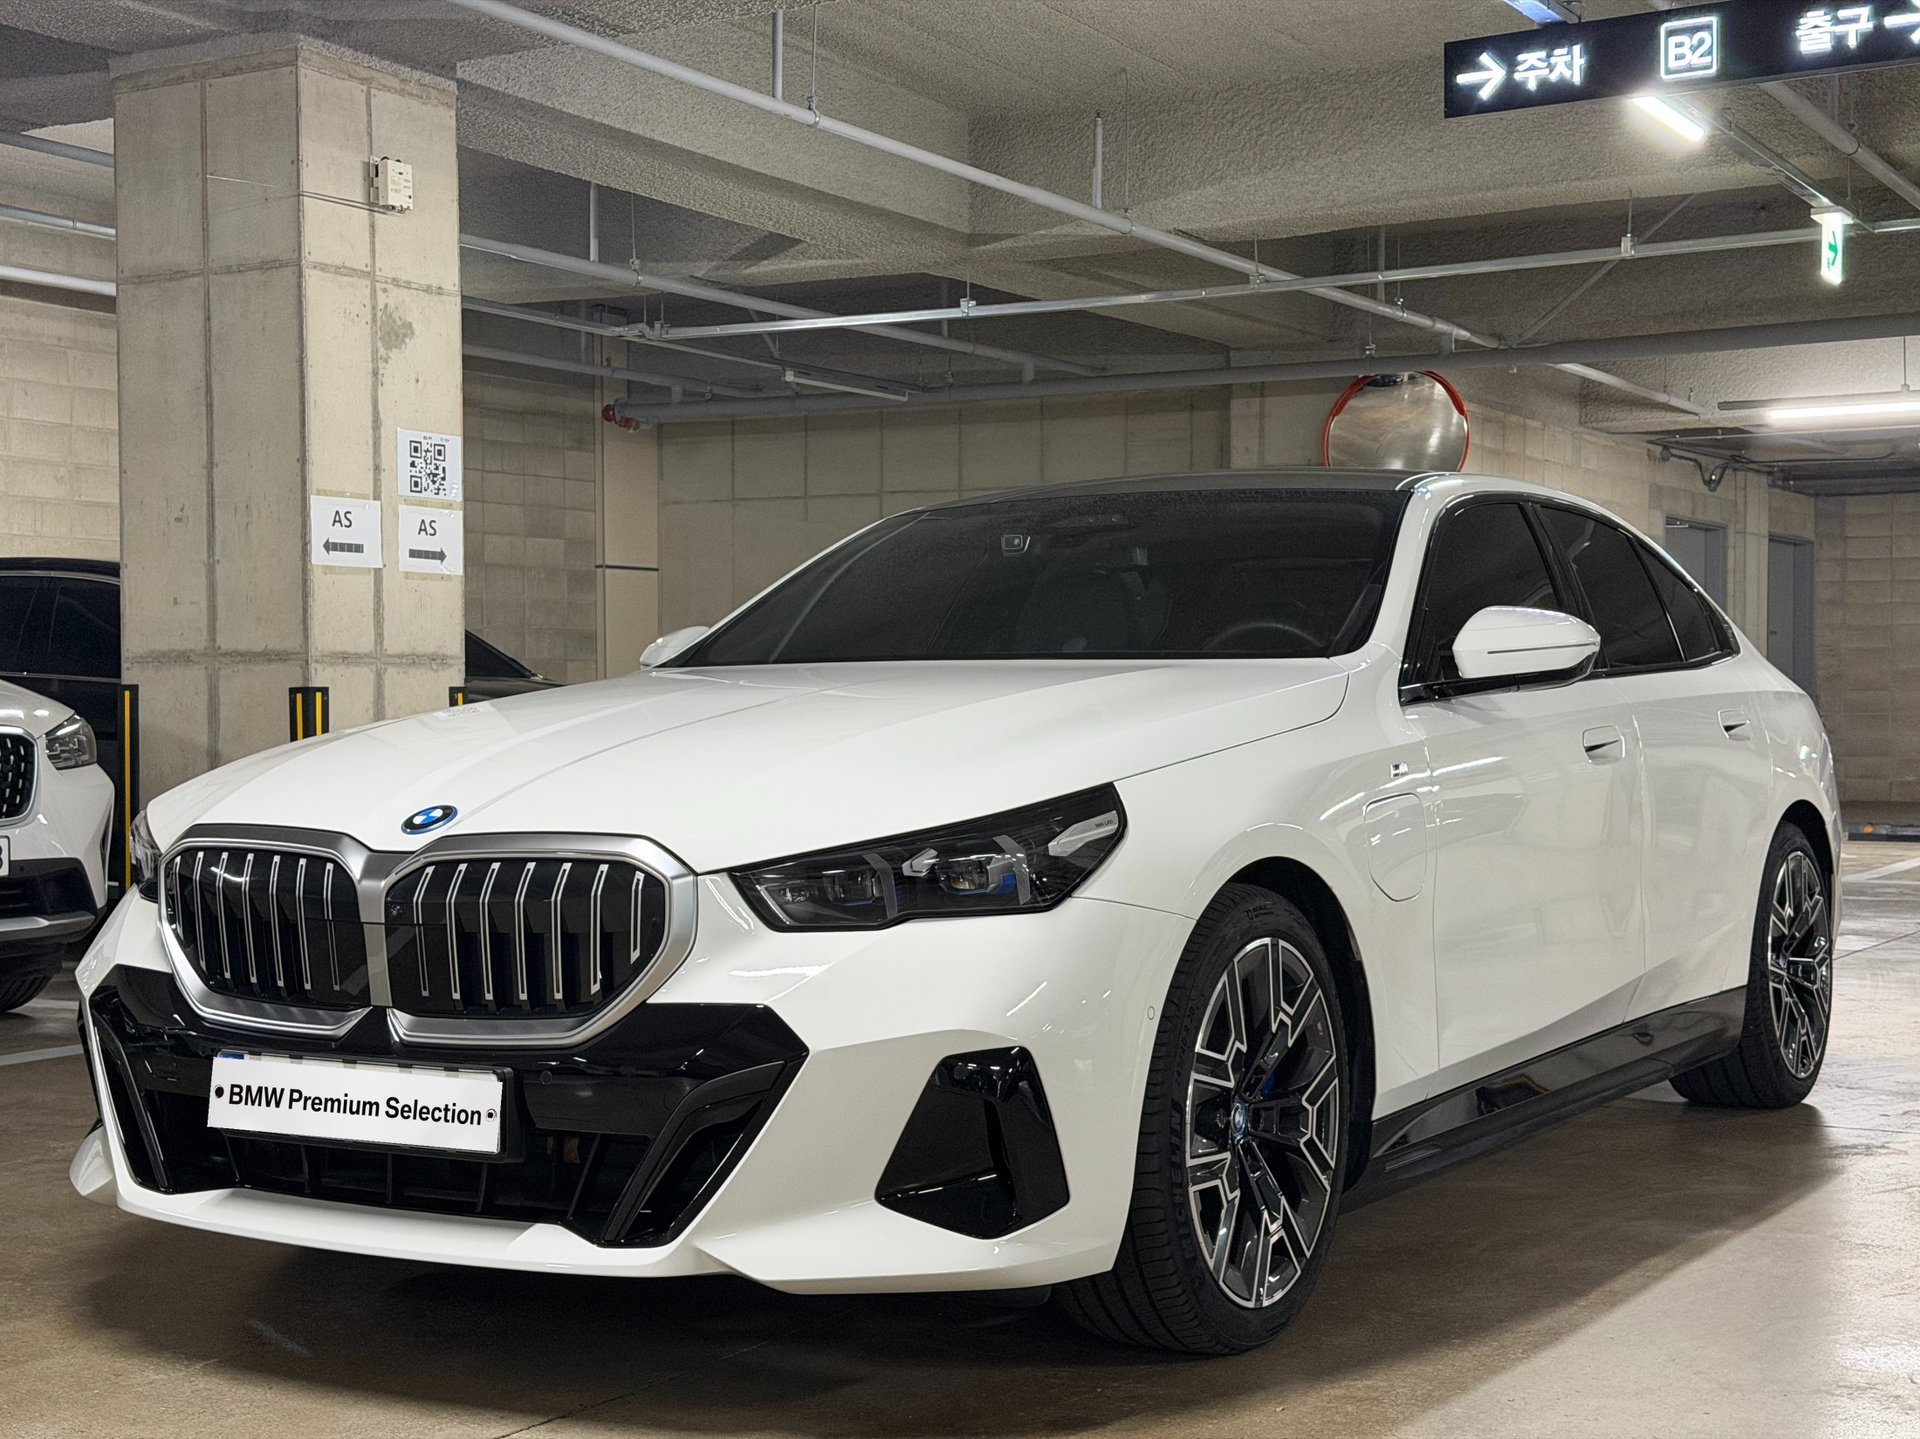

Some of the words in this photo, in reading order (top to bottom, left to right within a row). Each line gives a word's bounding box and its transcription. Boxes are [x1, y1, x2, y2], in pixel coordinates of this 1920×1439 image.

[1667, 31, 1713, 68] B2
[1795, 5, 1875, 54] 출구
[1514, 44, 1585, 91] 주차
[332, 510, 353, 528] AS
[417, 519, 437, 536] AS
[228, 1083, 285, 1109] BMW
[288, 1088, 380, 1117] Premium
[385, 1096, 482, 1126] Selection
